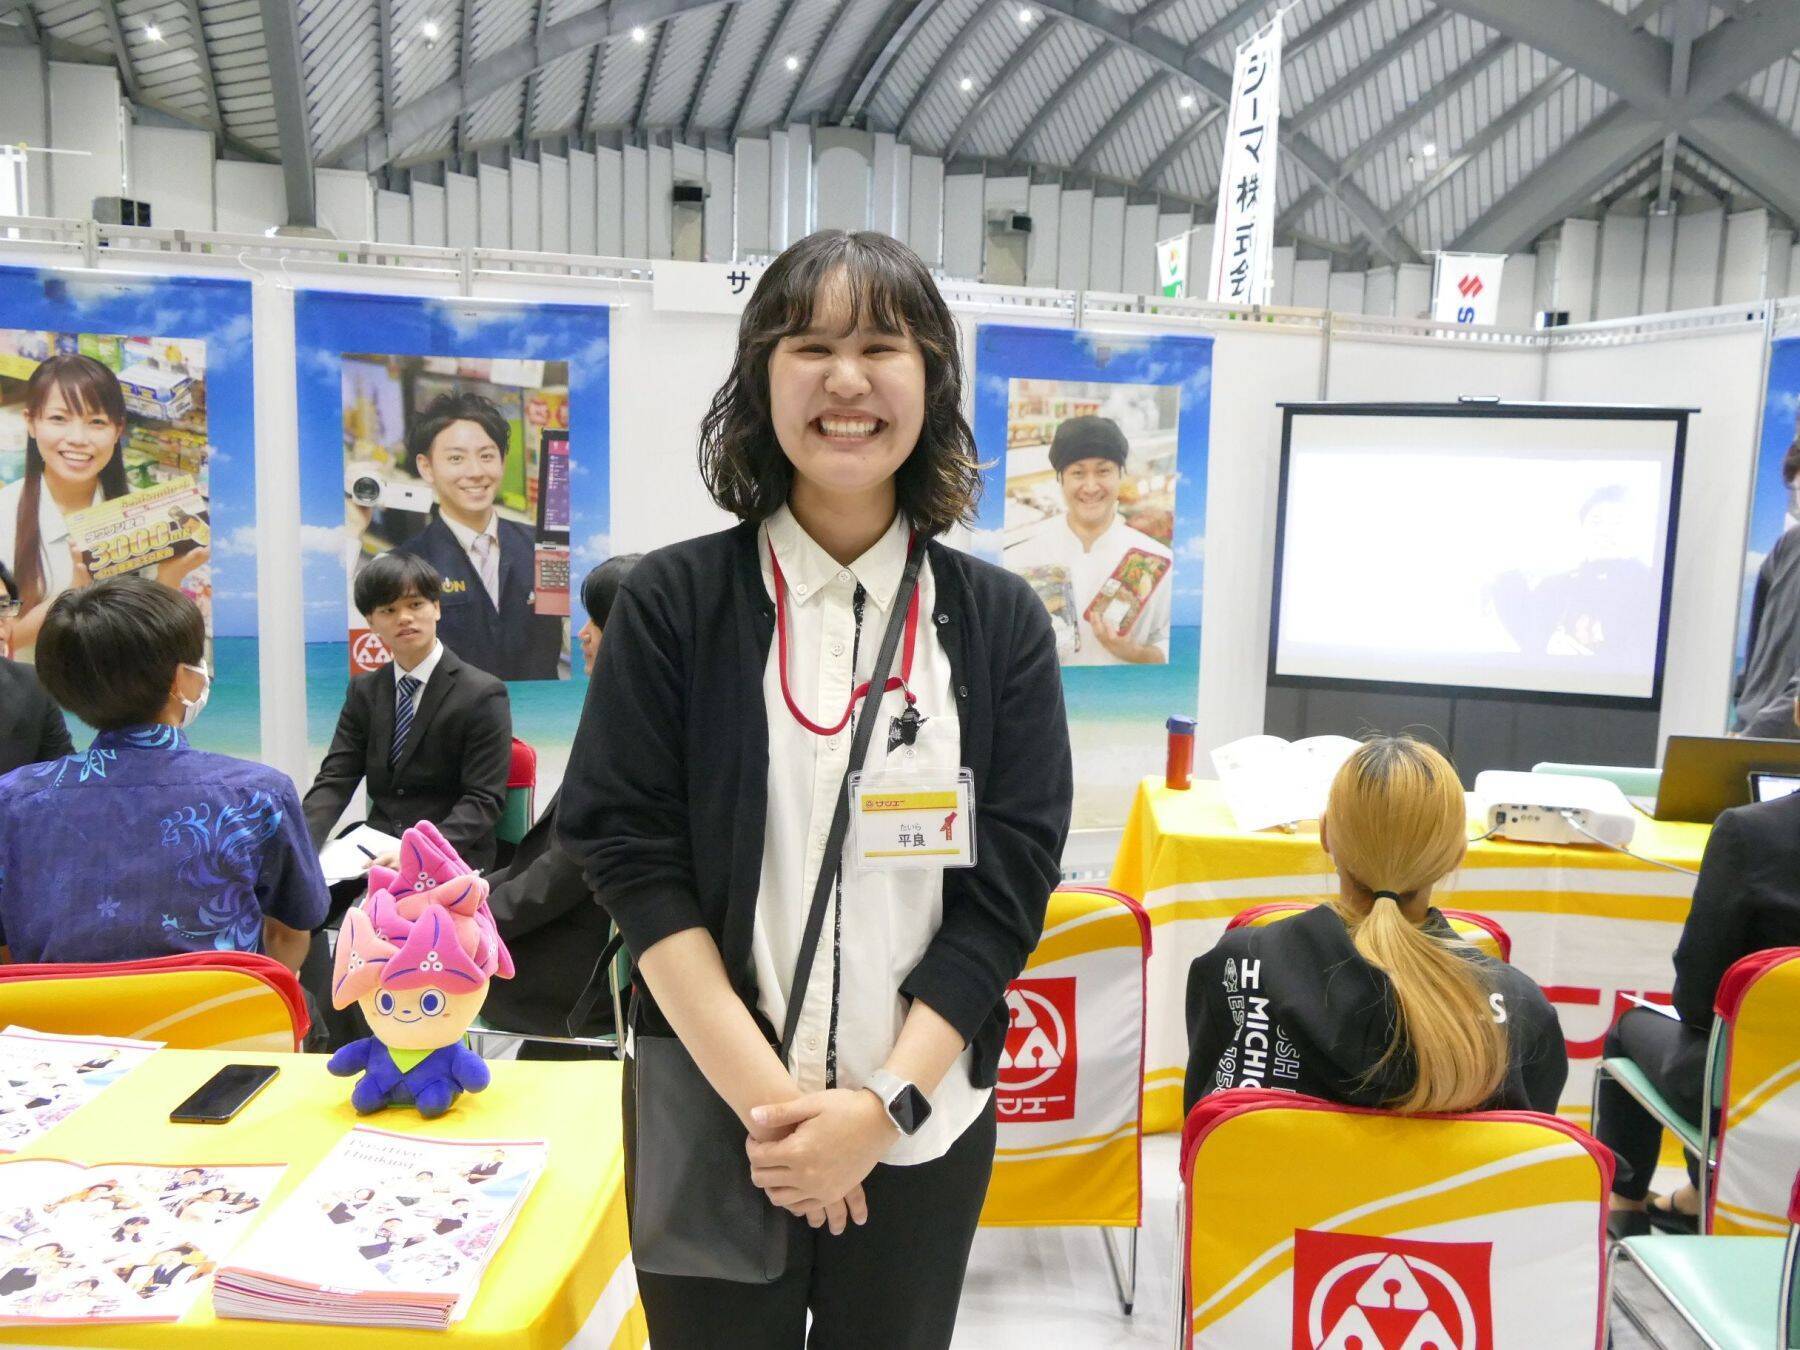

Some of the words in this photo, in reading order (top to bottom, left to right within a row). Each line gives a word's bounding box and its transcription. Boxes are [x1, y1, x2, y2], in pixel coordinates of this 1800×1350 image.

[900, 823, 922, 832] たいら
[898, 833, 926, 847] 平良
[1211, 1046, 1238, 1095] 195
